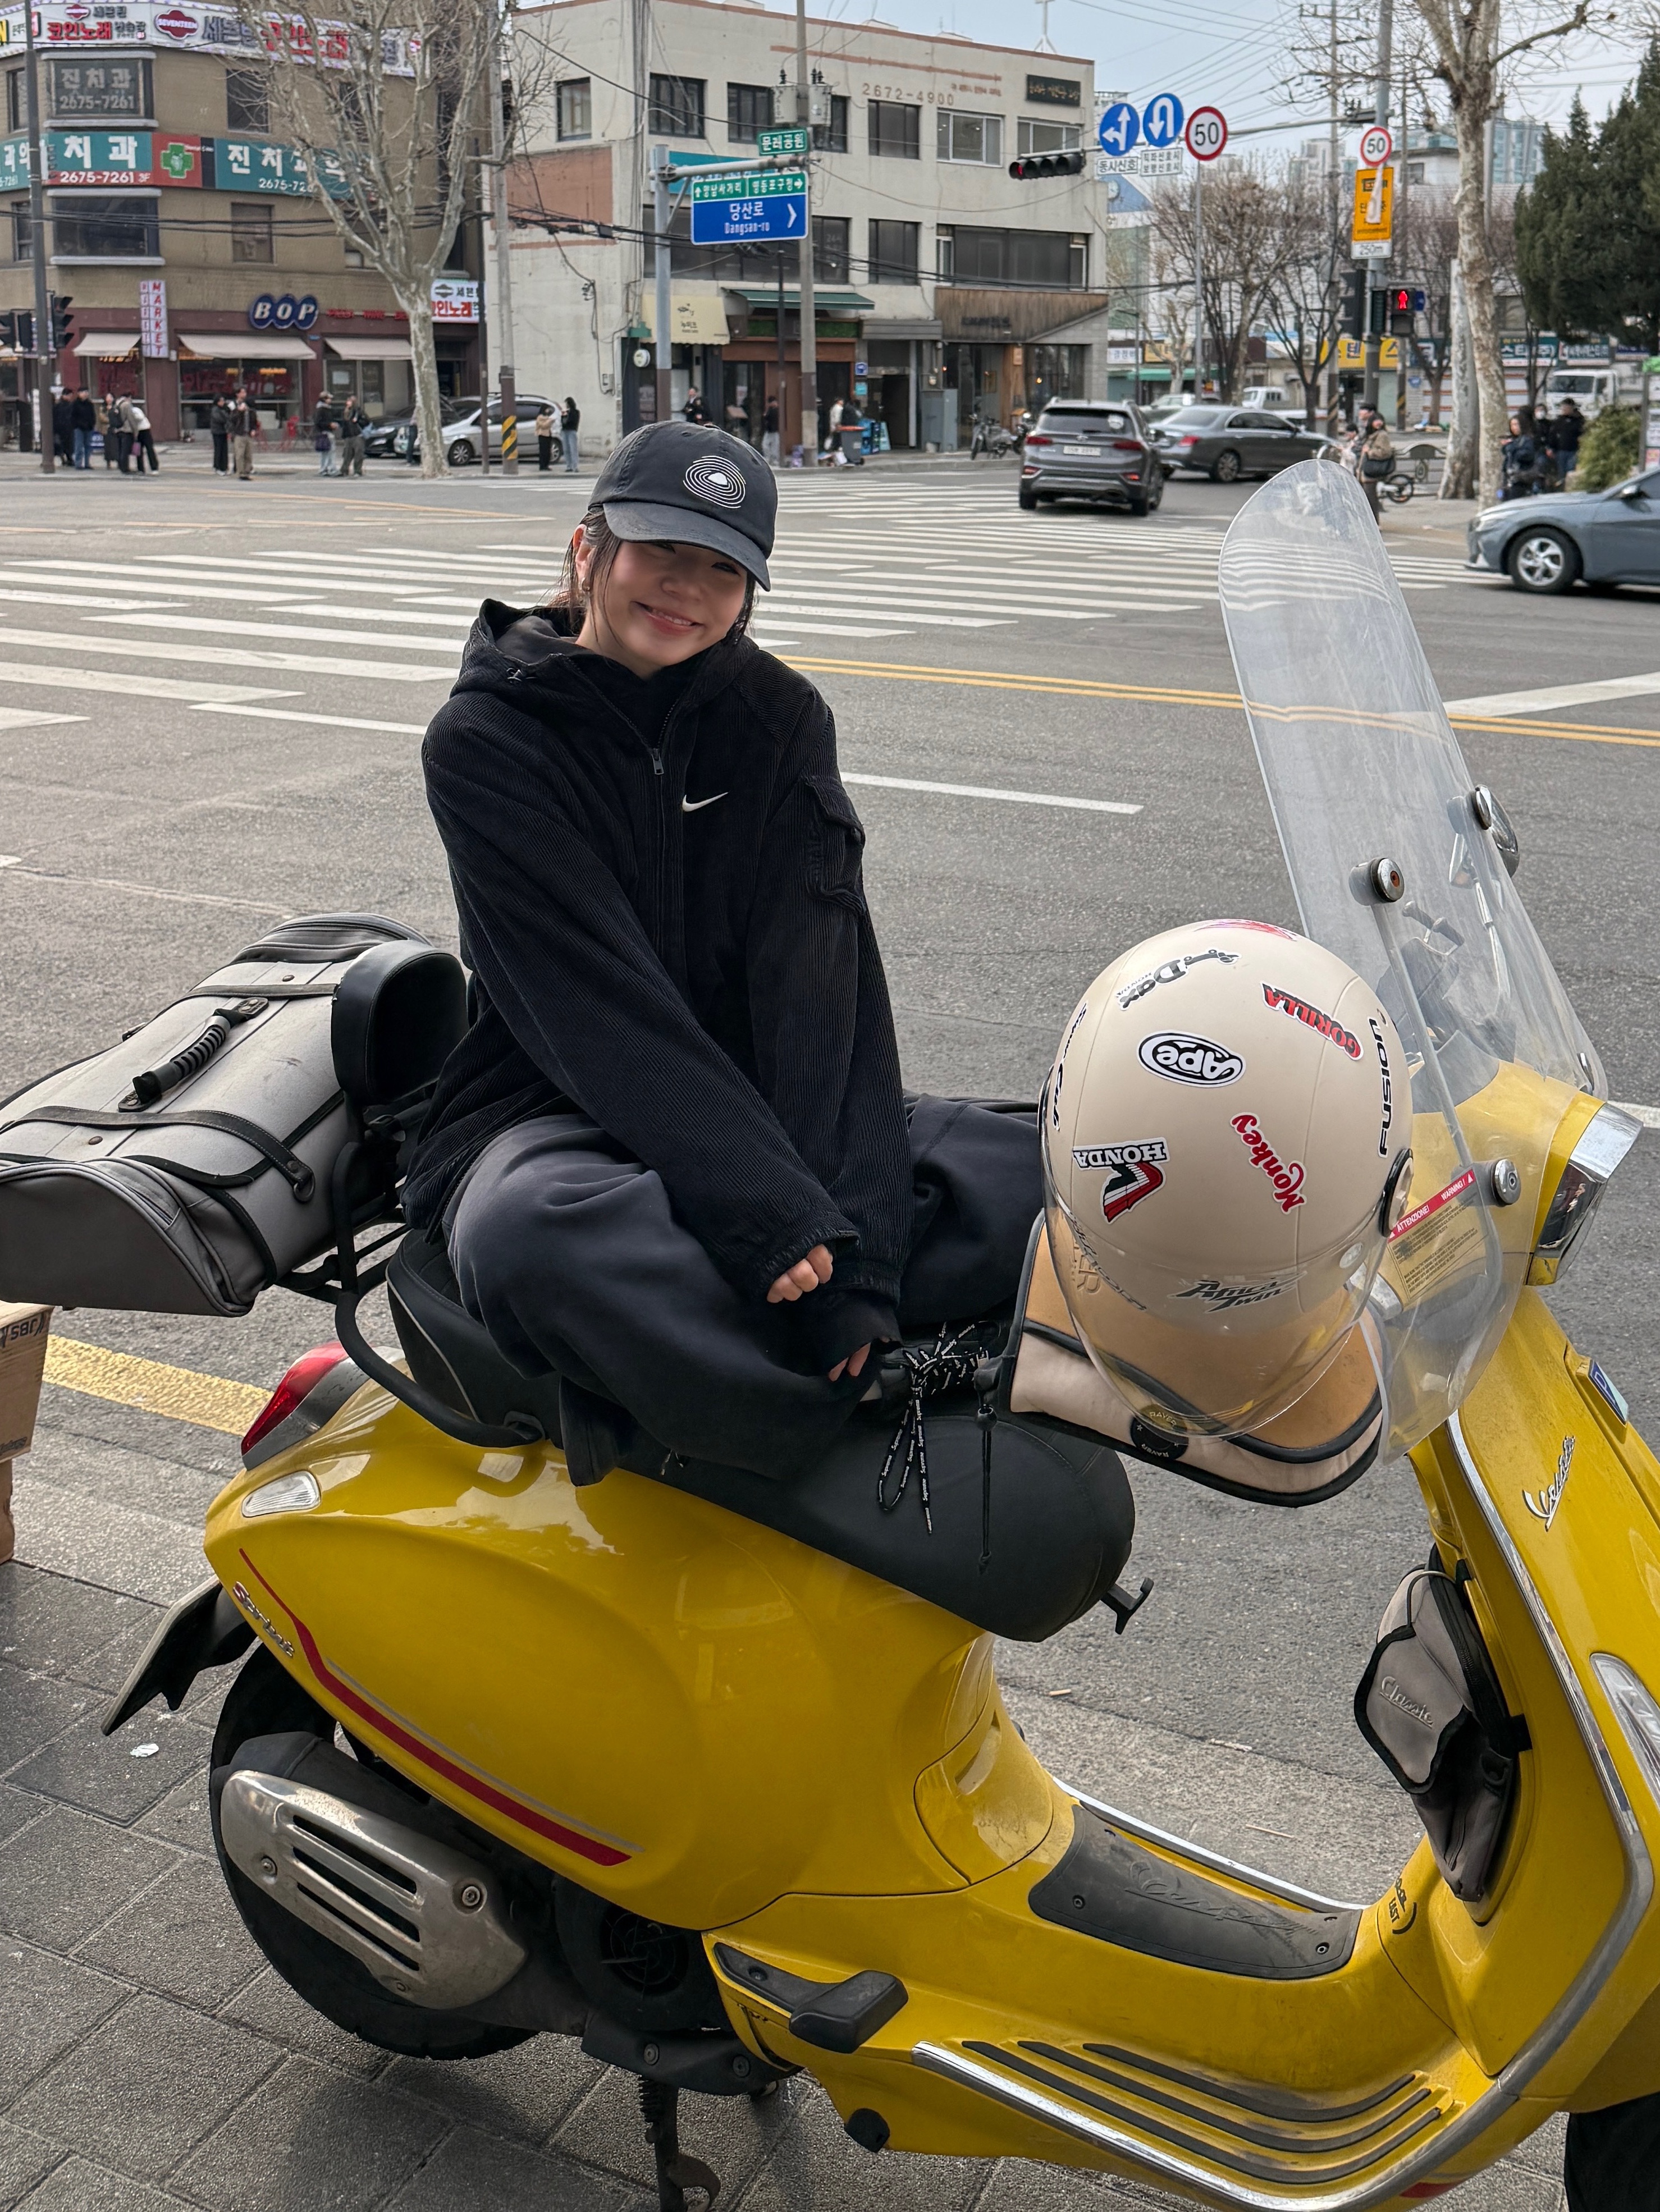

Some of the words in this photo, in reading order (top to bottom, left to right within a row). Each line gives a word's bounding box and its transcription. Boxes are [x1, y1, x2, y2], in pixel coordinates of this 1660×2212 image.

[60, 95, 134, 109] 2675-7261
[862, 83, 954, 106] 2672-4900
[1195, 122, 1219, 146] 50
[1367, 138, 1386, 154] 50
[60, 171, 134, 183] 2675-7261
[1099, 158, 1137, 173] 동시신호
[752, 178, 793, 194] 영등포구청
[730, 201, 765, 221] 당산로
[724, 222, 770, 236] Dangsan-ro
[152, 282, 163, 356] MARKET
[254, 301, 315, 320] BOP
[1116, 972, 1152, 997] HONDA
[1119, 959, 1186, 1009] Dax
[1262, 983, 1361, 1058] GORILLA
[1152, 1041, 1241, 1081] Ape
[1073, 1143, 1166, 1167] HONDA
[1232, 1115, 1305, 1212] Monkey
[1207, 1289, 1281, 1312] Twin
[11, 1318, 38, 1340] JBS
[233, 1581, 295, 1657] Sprint
[1381, 1675, 1433, 1726] Classic
